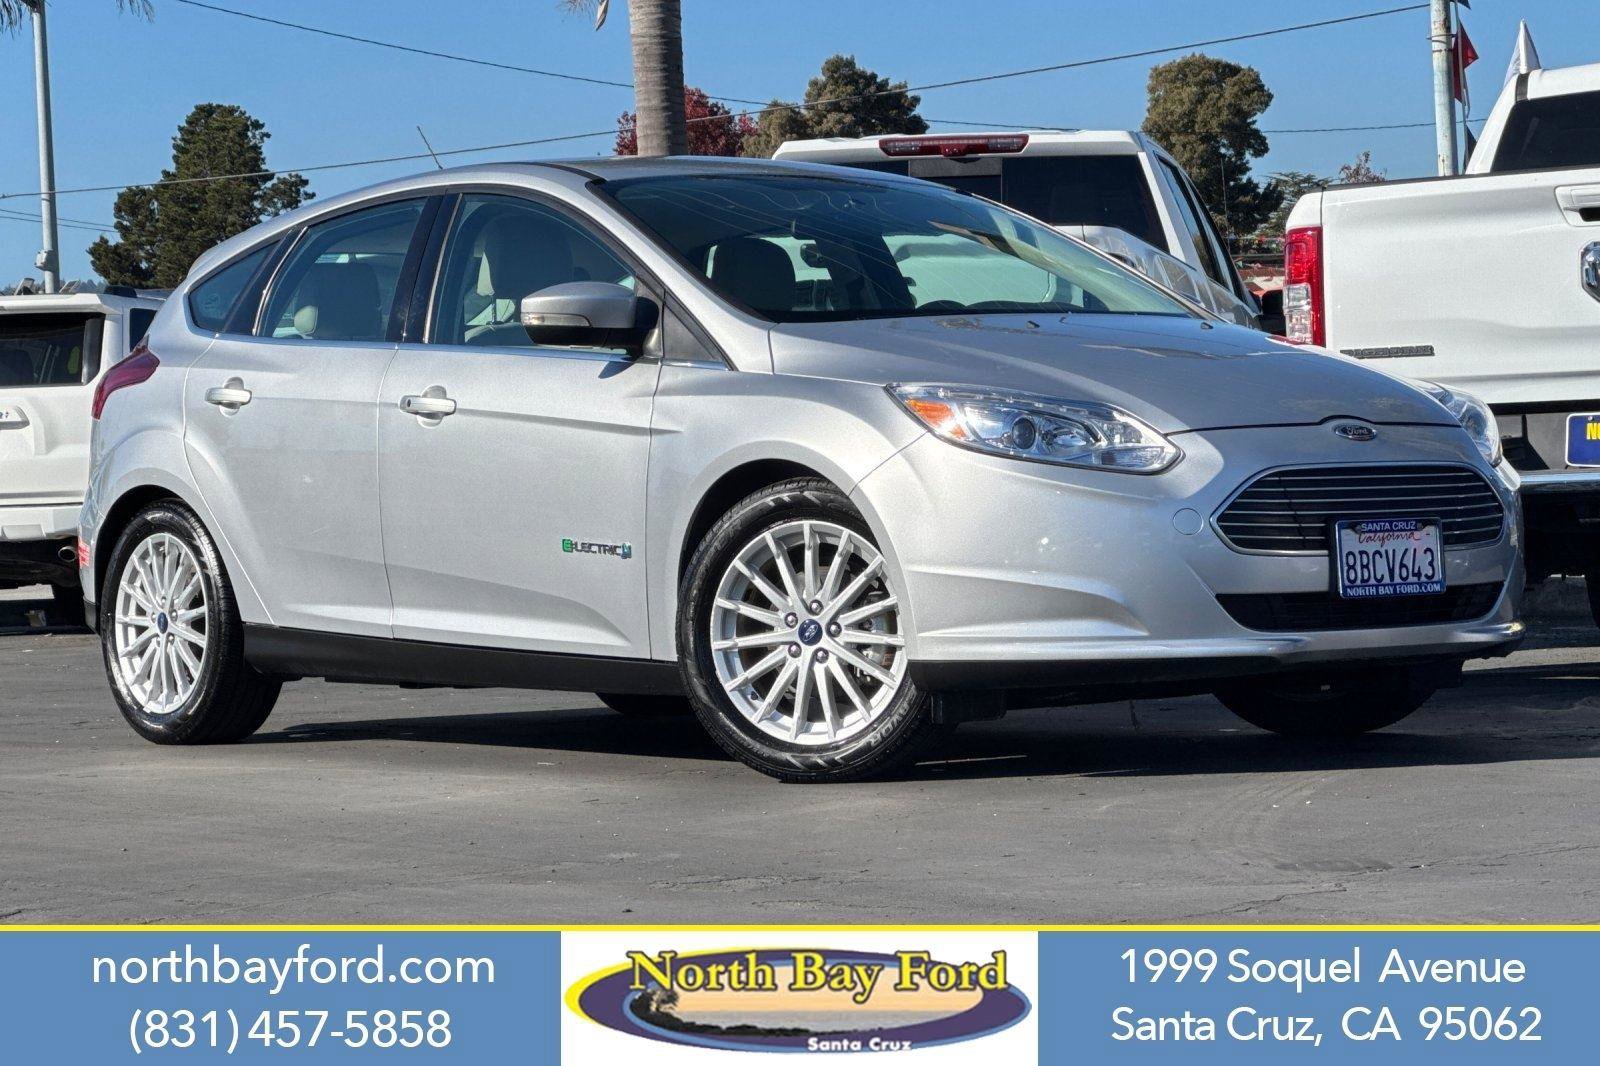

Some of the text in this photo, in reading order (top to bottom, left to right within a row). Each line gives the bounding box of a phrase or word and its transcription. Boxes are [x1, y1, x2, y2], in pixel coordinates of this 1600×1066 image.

[1361, 521, 1416, 531] SANTA CRUZ
[1358, 531, 1420, 547] California
[1345, 547, 1436, 584] 8BCV643
[1346, 583, 1441, 597] NORTH BAY FORD.COM
